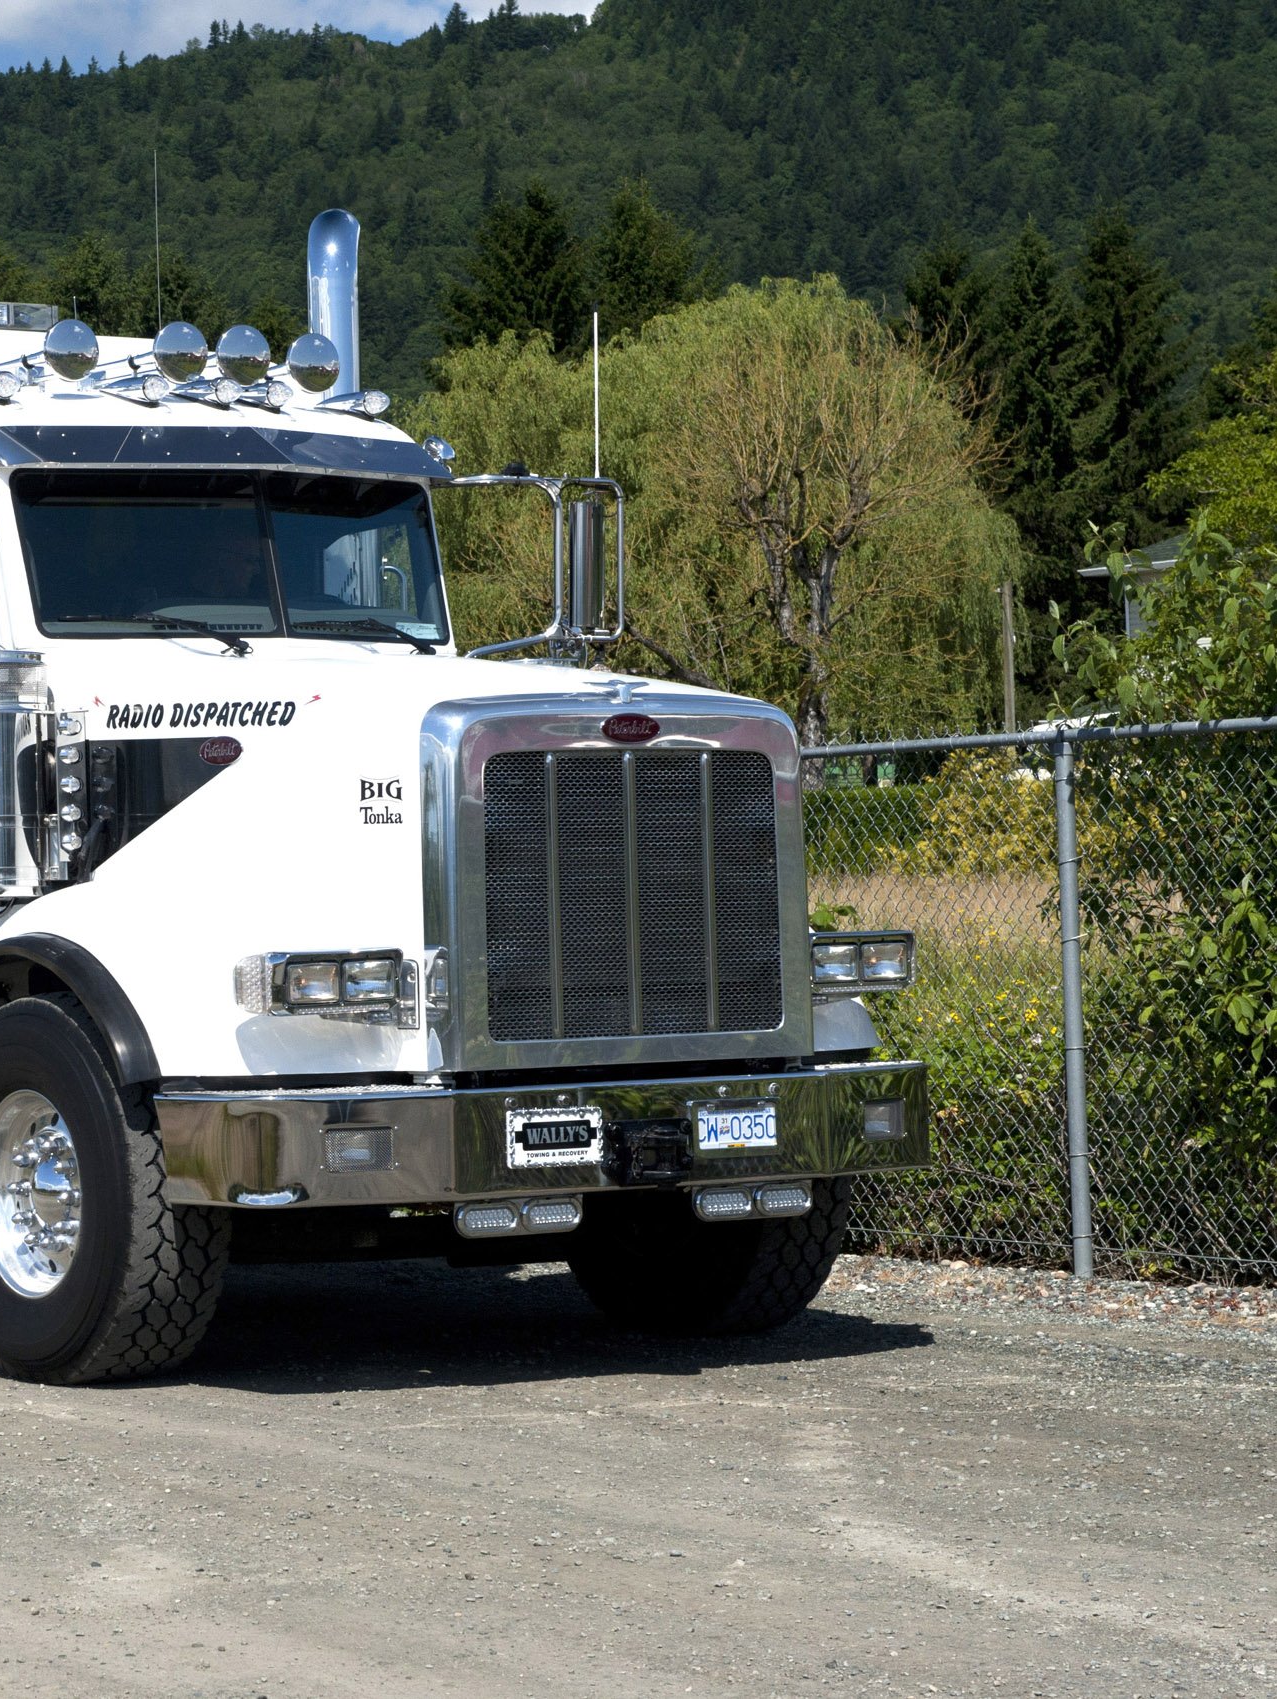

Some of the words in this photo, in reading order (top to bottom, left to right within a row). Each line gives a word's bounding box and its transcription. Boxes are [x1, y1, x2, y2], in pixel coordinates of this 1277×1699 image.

[107, 704, 163, 729] RADIO
[170, 701, 296, 728] DISPATCHED
[360, 778, 402, 801] BIG
[360, 806, 403, 825] Tonka
[526, 1125, 589, 1145] WALLY'S
[698, 1117, 719, 1143] CW
